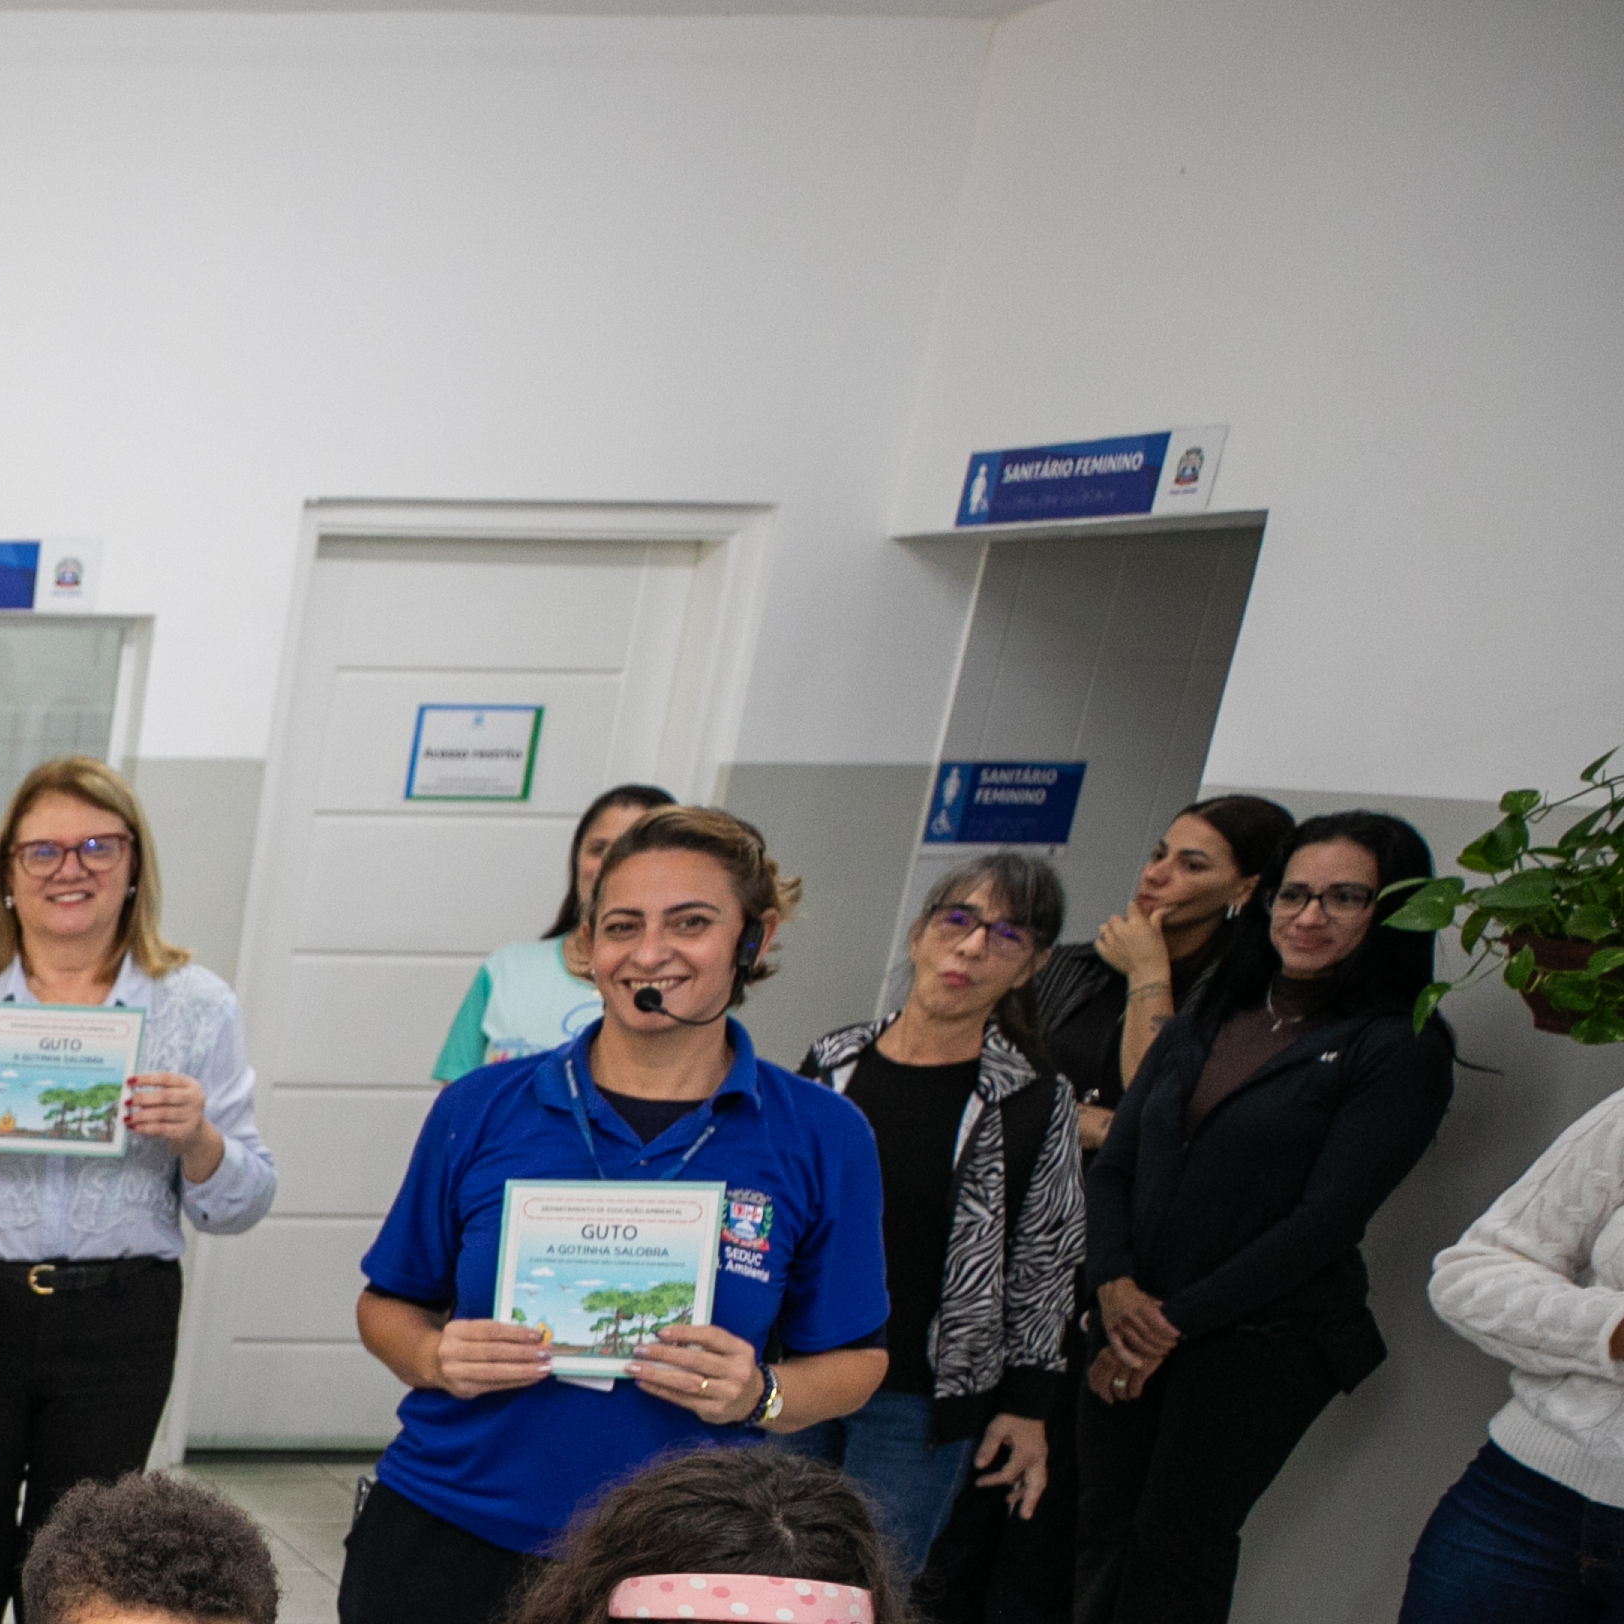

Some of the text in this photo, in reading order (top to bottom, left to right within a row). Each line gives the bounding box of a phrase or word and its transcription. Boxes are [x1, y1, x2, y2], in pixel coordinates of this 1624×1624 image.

[1002, 451, 1145, 484] SANITÁRIO FEMININO
[978, 765, 1059, 786] SANITÁRIO
[973, 787, 1047, 805] FEMININO
[40, 1038, 81, 1051] GUTO
[582, 1225, 637, 1240] GUTO
[547, 1245, 668, 1257] A GOTINHA SALOBRA
[724, 1246, 763, 1267] SEDUC
